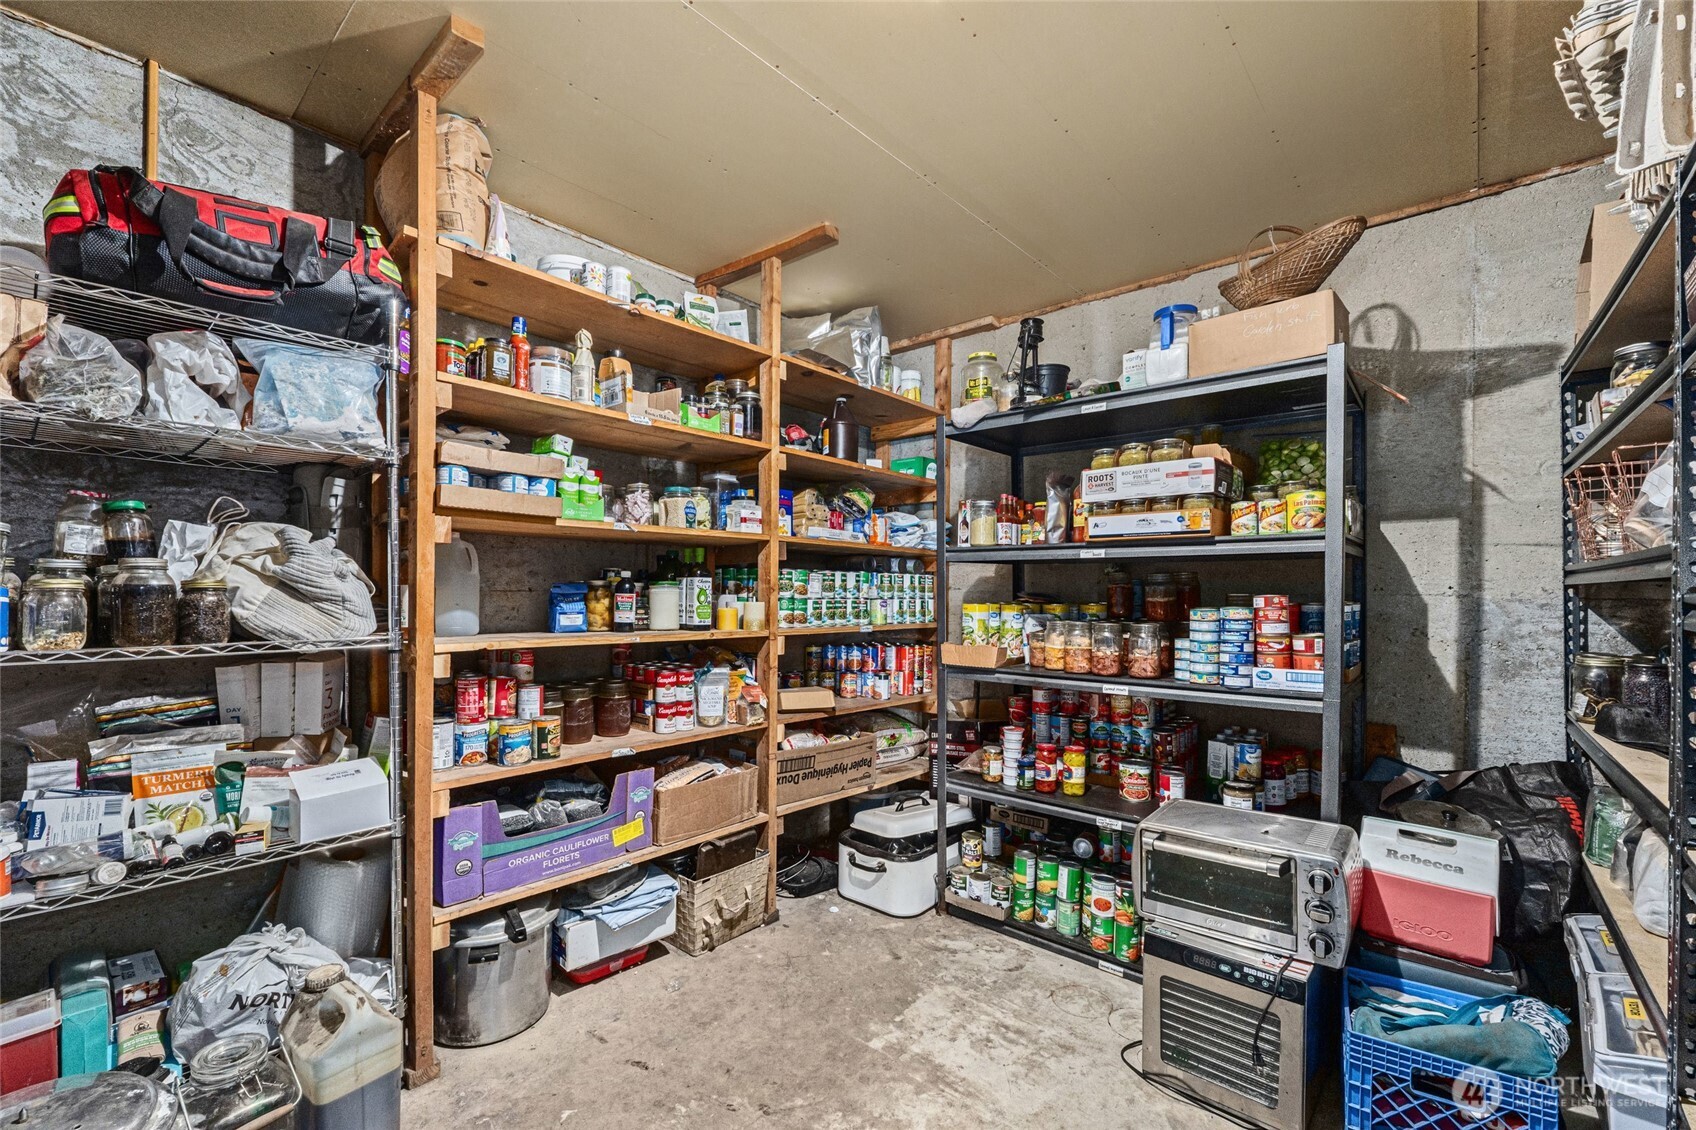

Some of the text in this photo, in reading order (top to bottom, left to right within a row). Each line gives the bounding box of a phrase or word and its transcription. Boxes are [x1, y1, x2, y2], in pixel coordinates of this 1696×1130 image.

[1088, 473, 1114, 483] ROOTS
[324, 687, 333, 709] 3
[776, 757, 873, 786] Papier Hygiénique Doux
[149, 779, 211, 795] MATCHA
[508, 833, 610, 868] ORGANIC CAULIFLOWER
[542, 851, 581, 869] FLORETS
[1385, 848, 1465, 875] Rebecca
